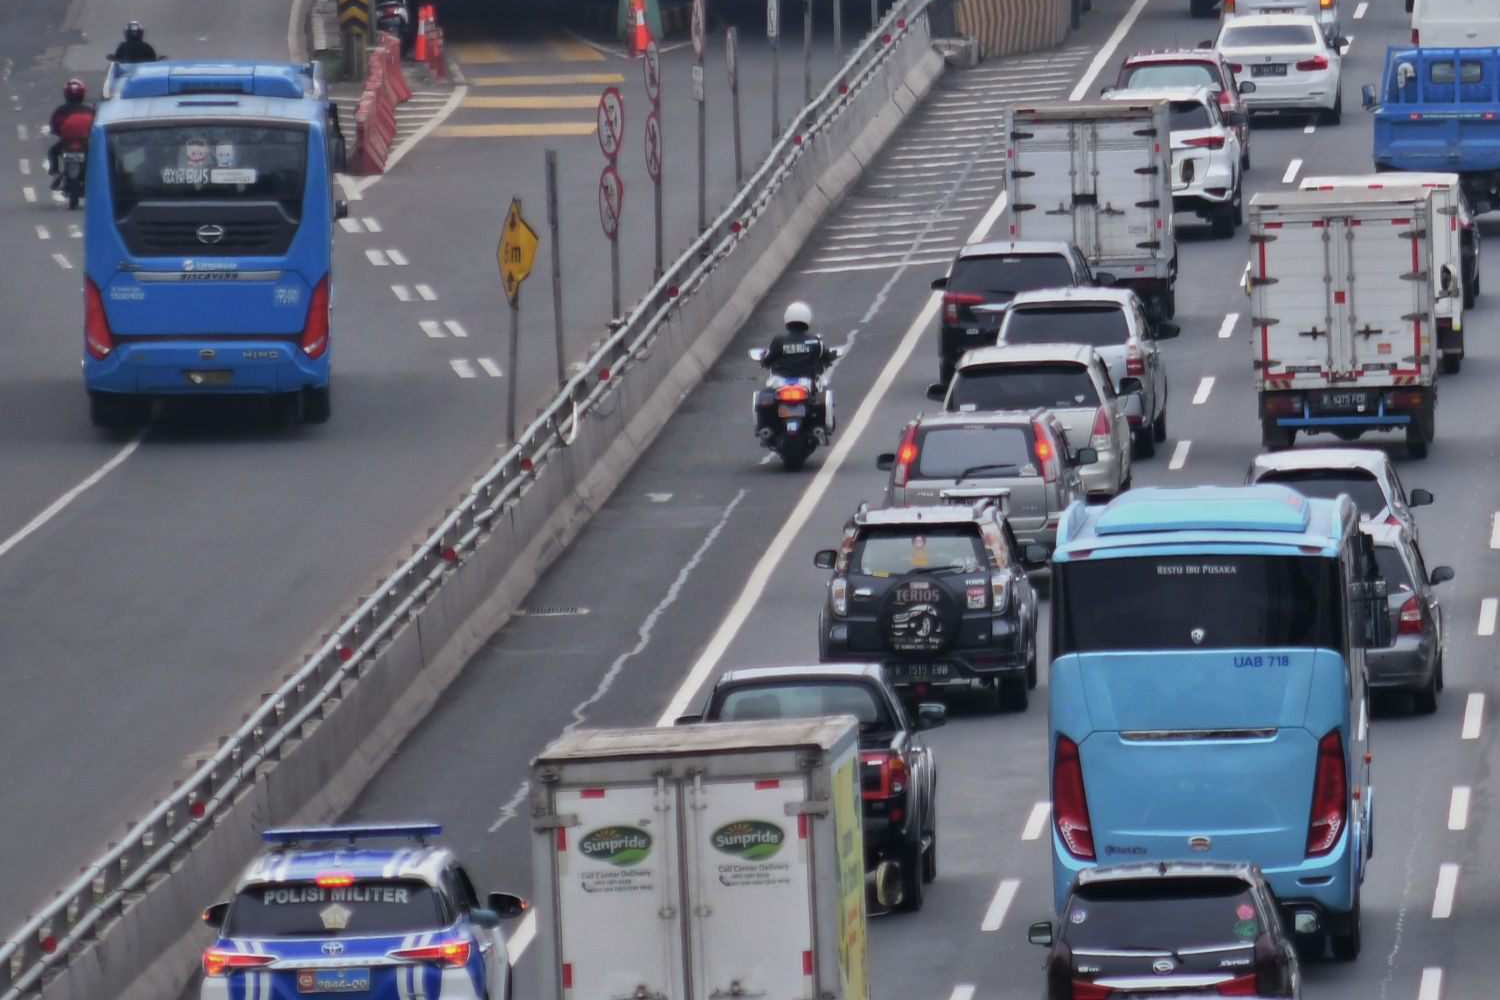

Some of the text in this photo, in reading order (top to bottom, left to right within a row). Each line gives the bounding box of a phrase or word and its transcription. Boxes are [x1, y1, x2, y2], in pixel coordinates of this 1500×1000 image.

[896, 589, 940, 602] TERIOS
[1234, 655, 1289, 668] UAB 718
[583, 839, 647, 854] Sunpride
[716, 832, 779, 848] Sunpride
[264, 887, 408, 905] POLISI MILITER
